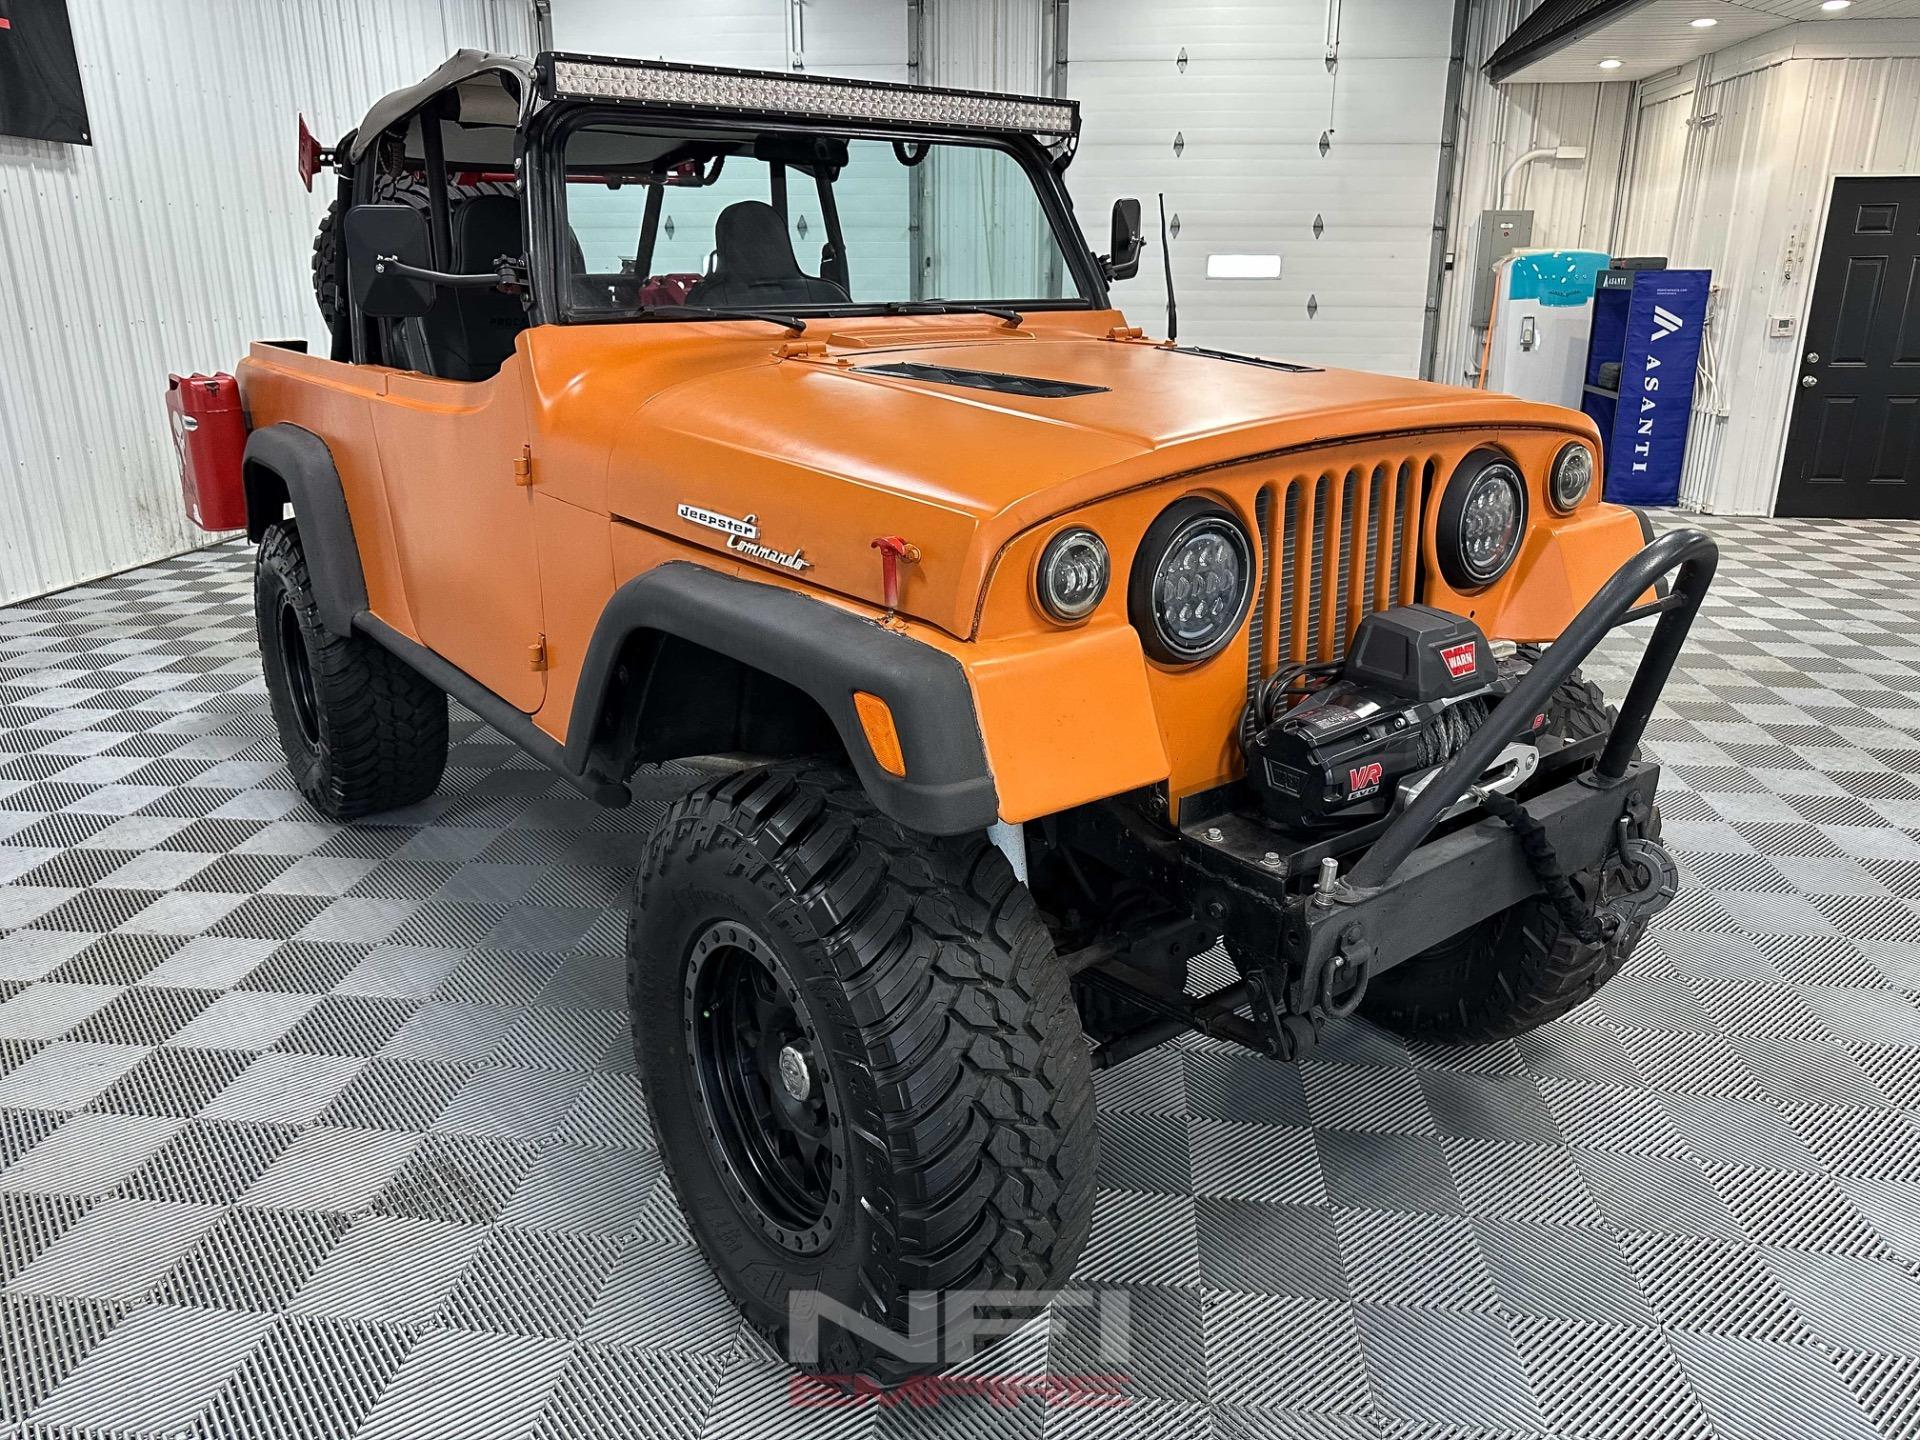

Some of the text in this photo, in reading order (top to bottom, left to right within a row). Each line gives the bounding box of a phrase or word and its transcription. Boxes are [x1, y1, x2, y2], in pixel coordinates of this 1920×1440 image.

[1632, 354, 1662, 473] ASANTI
[680, 506, 753, 535] Jeepster
[726, 514, 810, 570] Commando
[1448, 652, 1473, 669] WARN
[1349, 762, 1383, 791] VR
[1350, 786, 1378, 799] EVO
